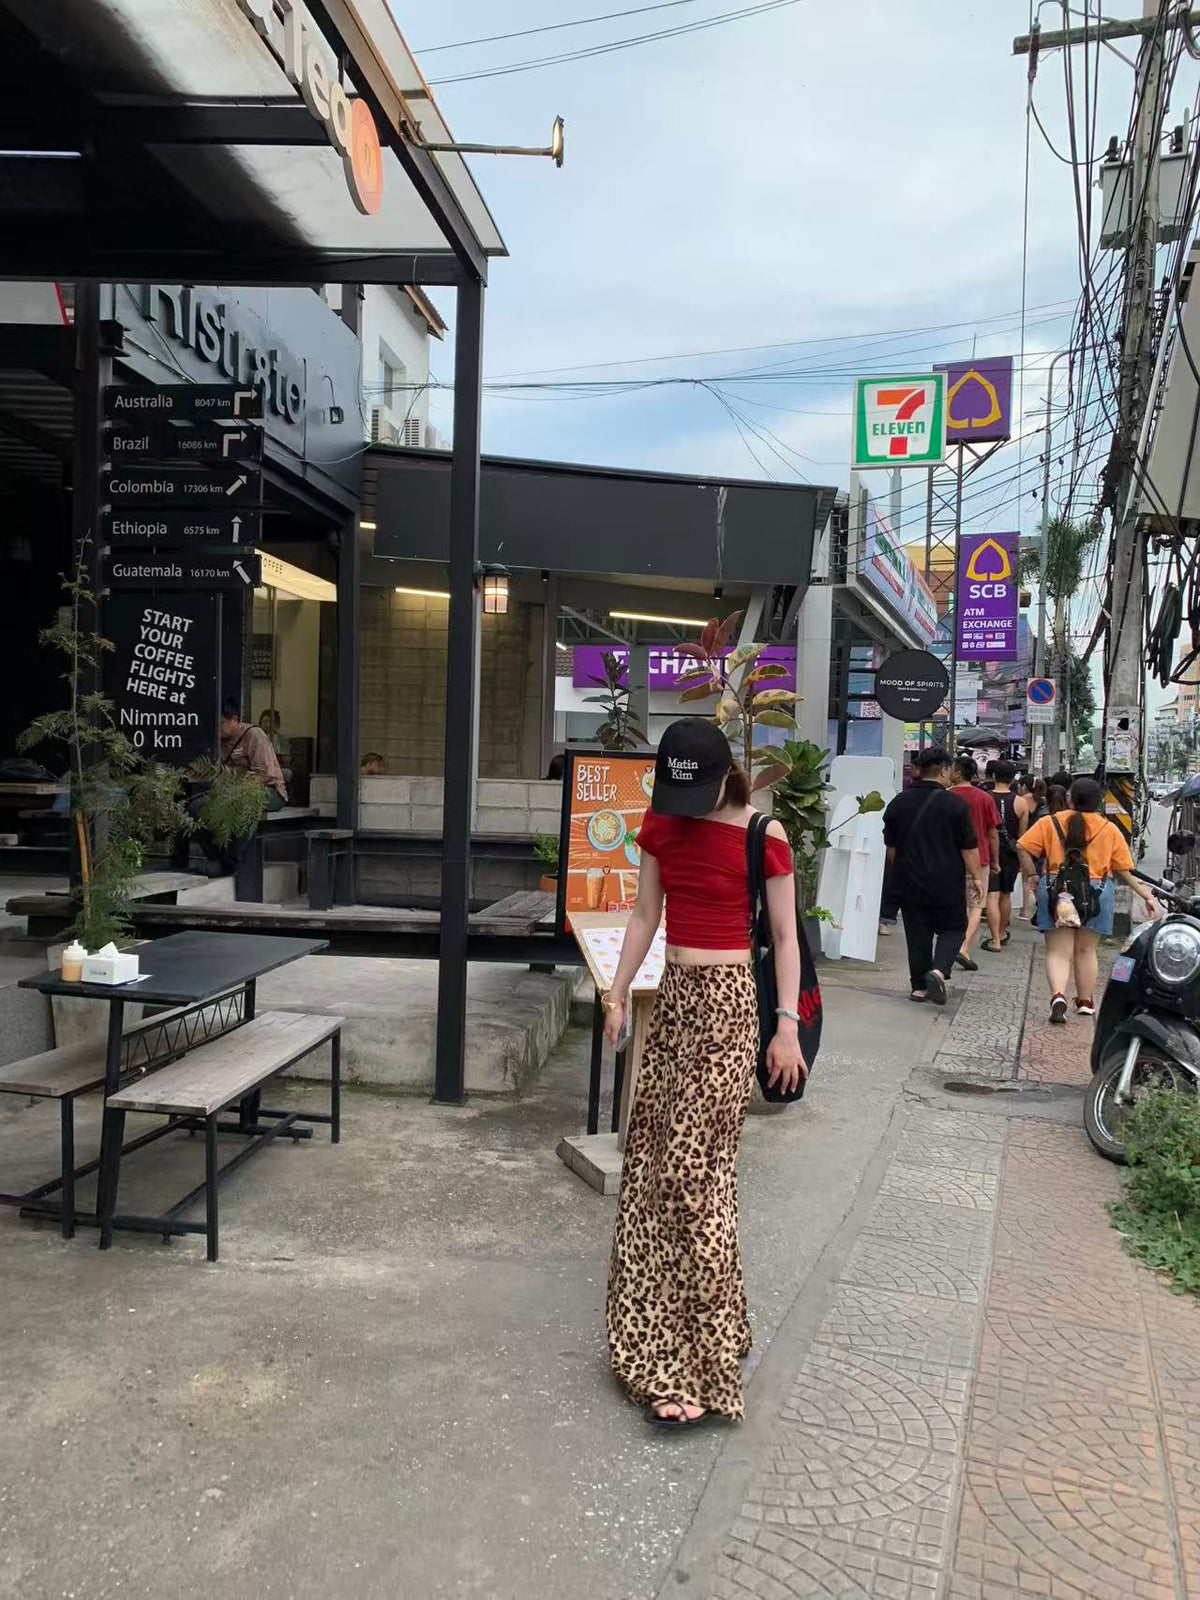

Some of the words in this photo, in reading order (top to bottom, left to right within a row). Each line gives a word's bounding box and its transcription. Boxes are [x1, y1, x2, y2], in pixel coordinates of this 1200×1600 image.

[114, 394, 173, 408] Australia
[194, 398, 215, 407] 8047
[217, 398, 231, 407] km
[877, 388, 925, 455] 7
[113, 436, 149, 450] Brazil
[177, 440, 203, 449] 16086
[204, 440, 218, 449] km
[109, 479, 174, 494] Colombia
[183, 484, 208, 493] 17306
[210, 484, 223, 493] km
[112, 521, 168, 537] Ethiopia
[183, 526, 205, 535] 6575
[206, 526, 219, 535] km
[112, 563, 182, 577] Guatemala
[190, 568, 215, 577] 16170
[216, 568, 230, 577] km
[969, 584, 1007, 599] SCB
[142, 608, 194, 633] START
[963, 608, 985, 617] ATM
[962, 619, 1013, 629] EXCHANGE
[140, 625, 184, 650] YOUR
[134, 643, 195, 670] COFFEE
[129, 660, 196, 689] FLIGHTS
[126, 677, 168, 700] HERE
[169, 691, 187, 706] at
[917, 680, 945, 688] SPIRITS
[120, 708, 199, 726] Nimman
[133, 730, 145, 748] 0
[154, 729, 182, 748] km
[667, 756, 699, 770] Matin
[576, 764, 611, 784] BEST
[671, 769, 694, 780] Kim
[576, 783, 618, 803] SELLER
